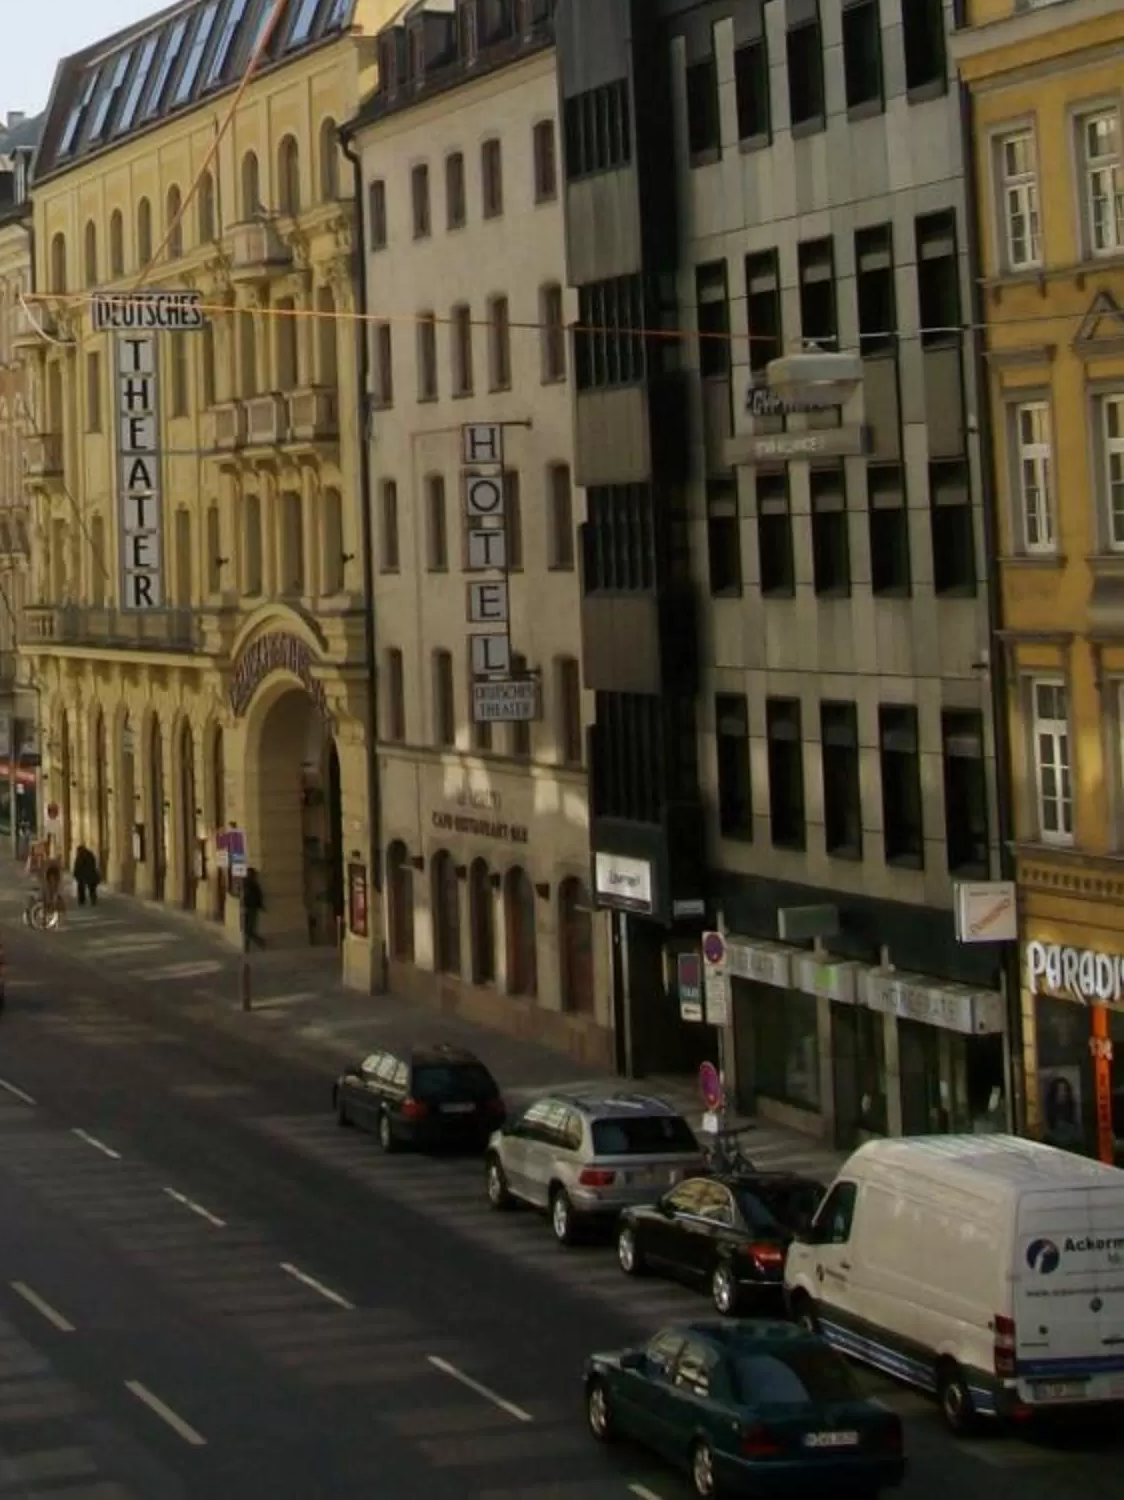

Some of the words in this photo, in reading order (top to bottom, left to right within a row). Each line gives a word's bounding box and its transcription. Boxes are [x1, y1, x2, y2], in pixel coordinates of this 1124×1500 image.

[97, 295, 201, 327] DEUTSCHES
[124, 338, 154, 606] THEATER
[469, 427, 505, 671] HOTEL
[1027, 941, 1124, 1005] PARADI
